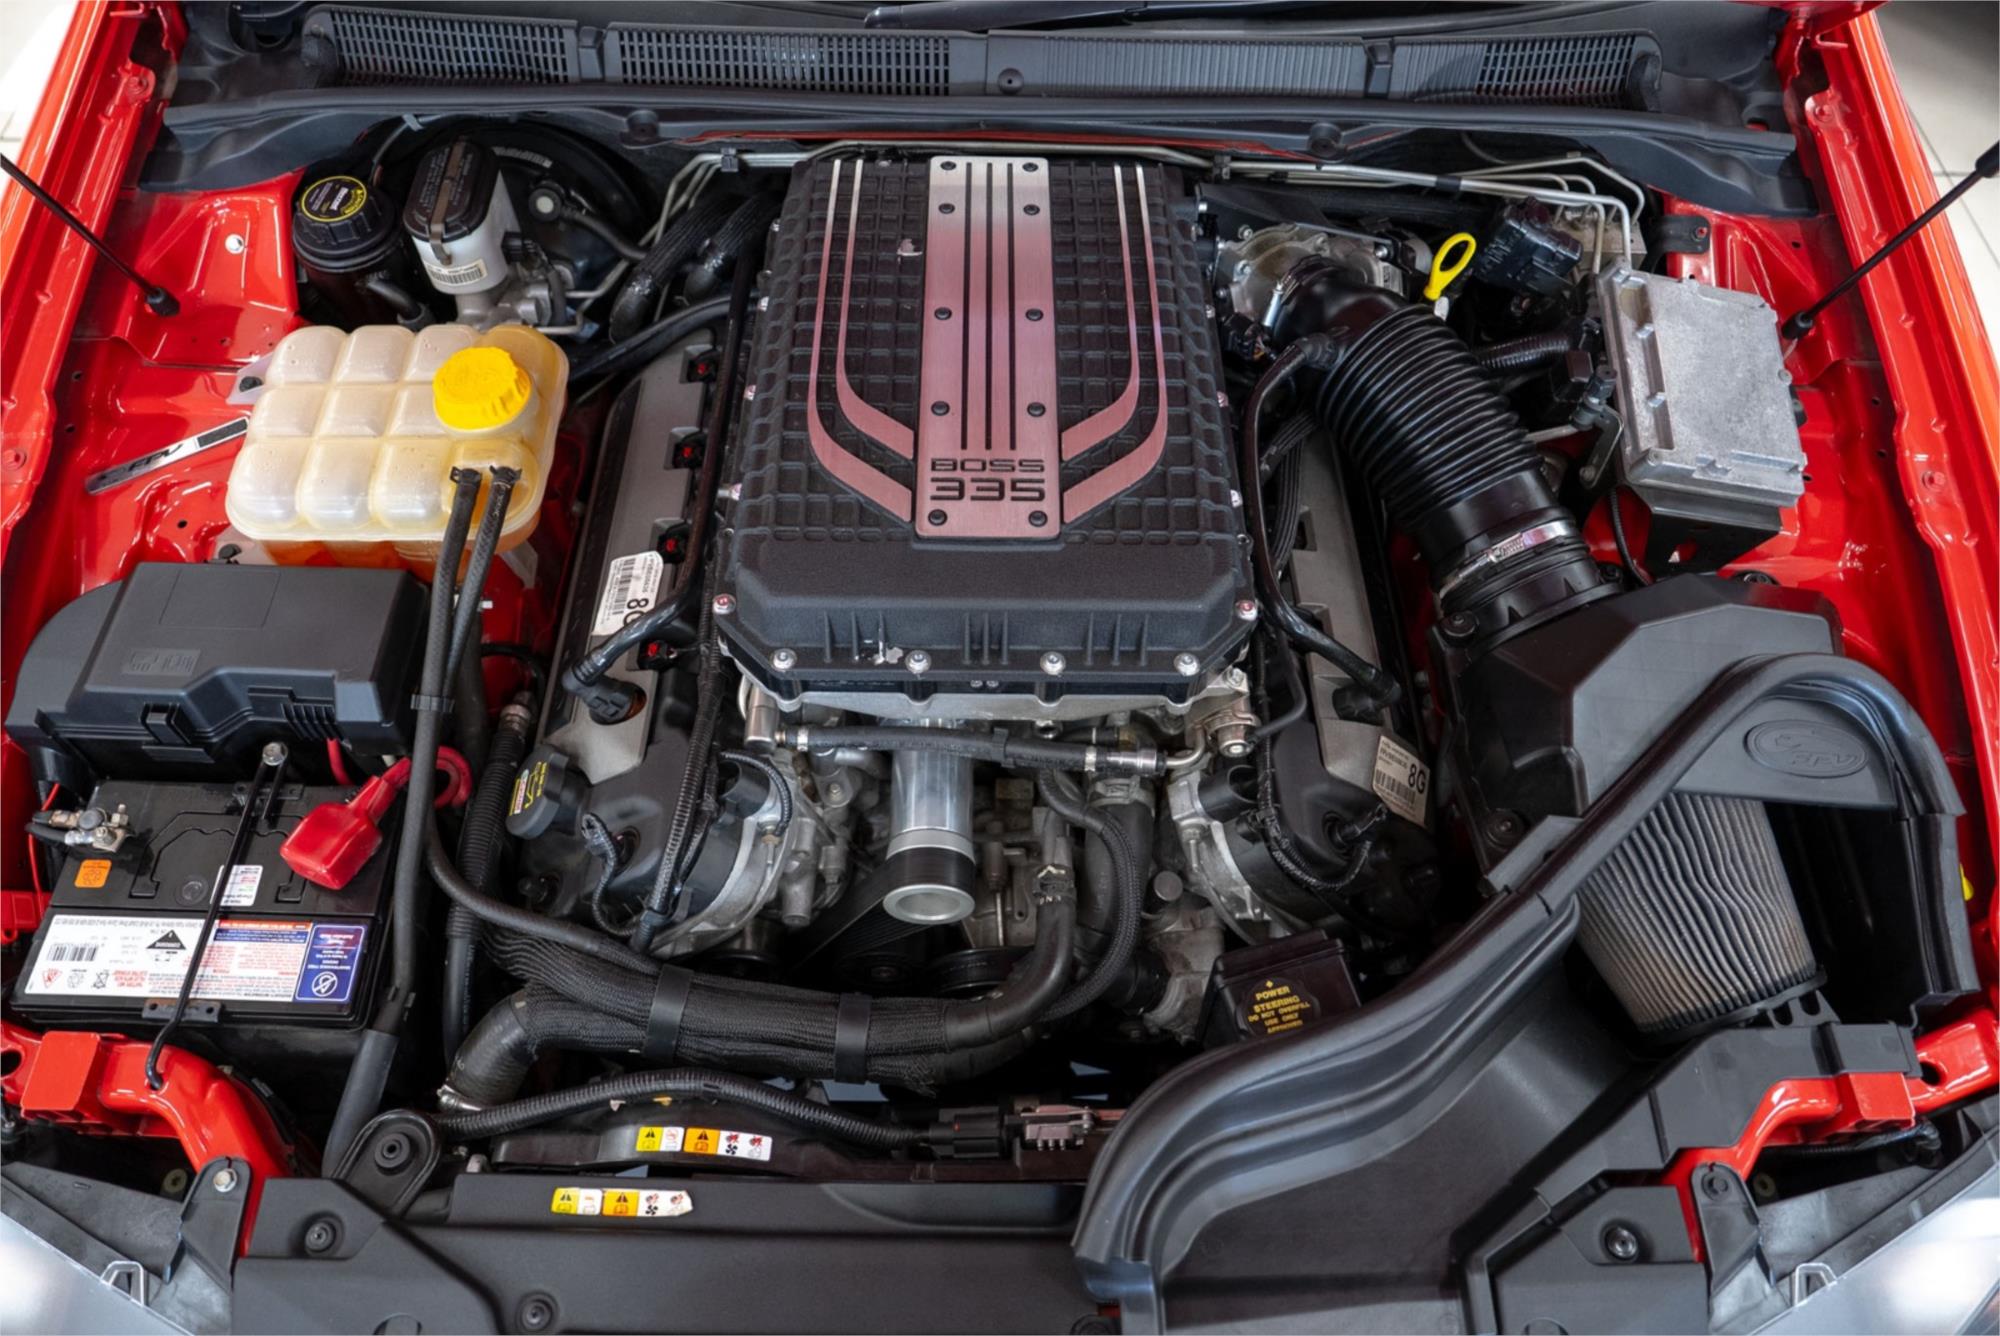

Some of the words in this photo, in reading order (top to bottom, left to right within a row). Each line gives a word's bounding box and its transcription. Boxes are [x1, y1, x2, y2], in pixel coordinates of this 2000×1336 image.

[930, 458, 1045, 472] BOSS
[930, 477, 1046, 501] 335
[1408, 763, 1427, 794] 8G
[1255, 986, 1291, 1001] POWER
[1253, 995, 1300, 1013] STEERING
[1247, 1014, 1260, 1023] DO
[1261, 1010, 1276, 1019] NOT
